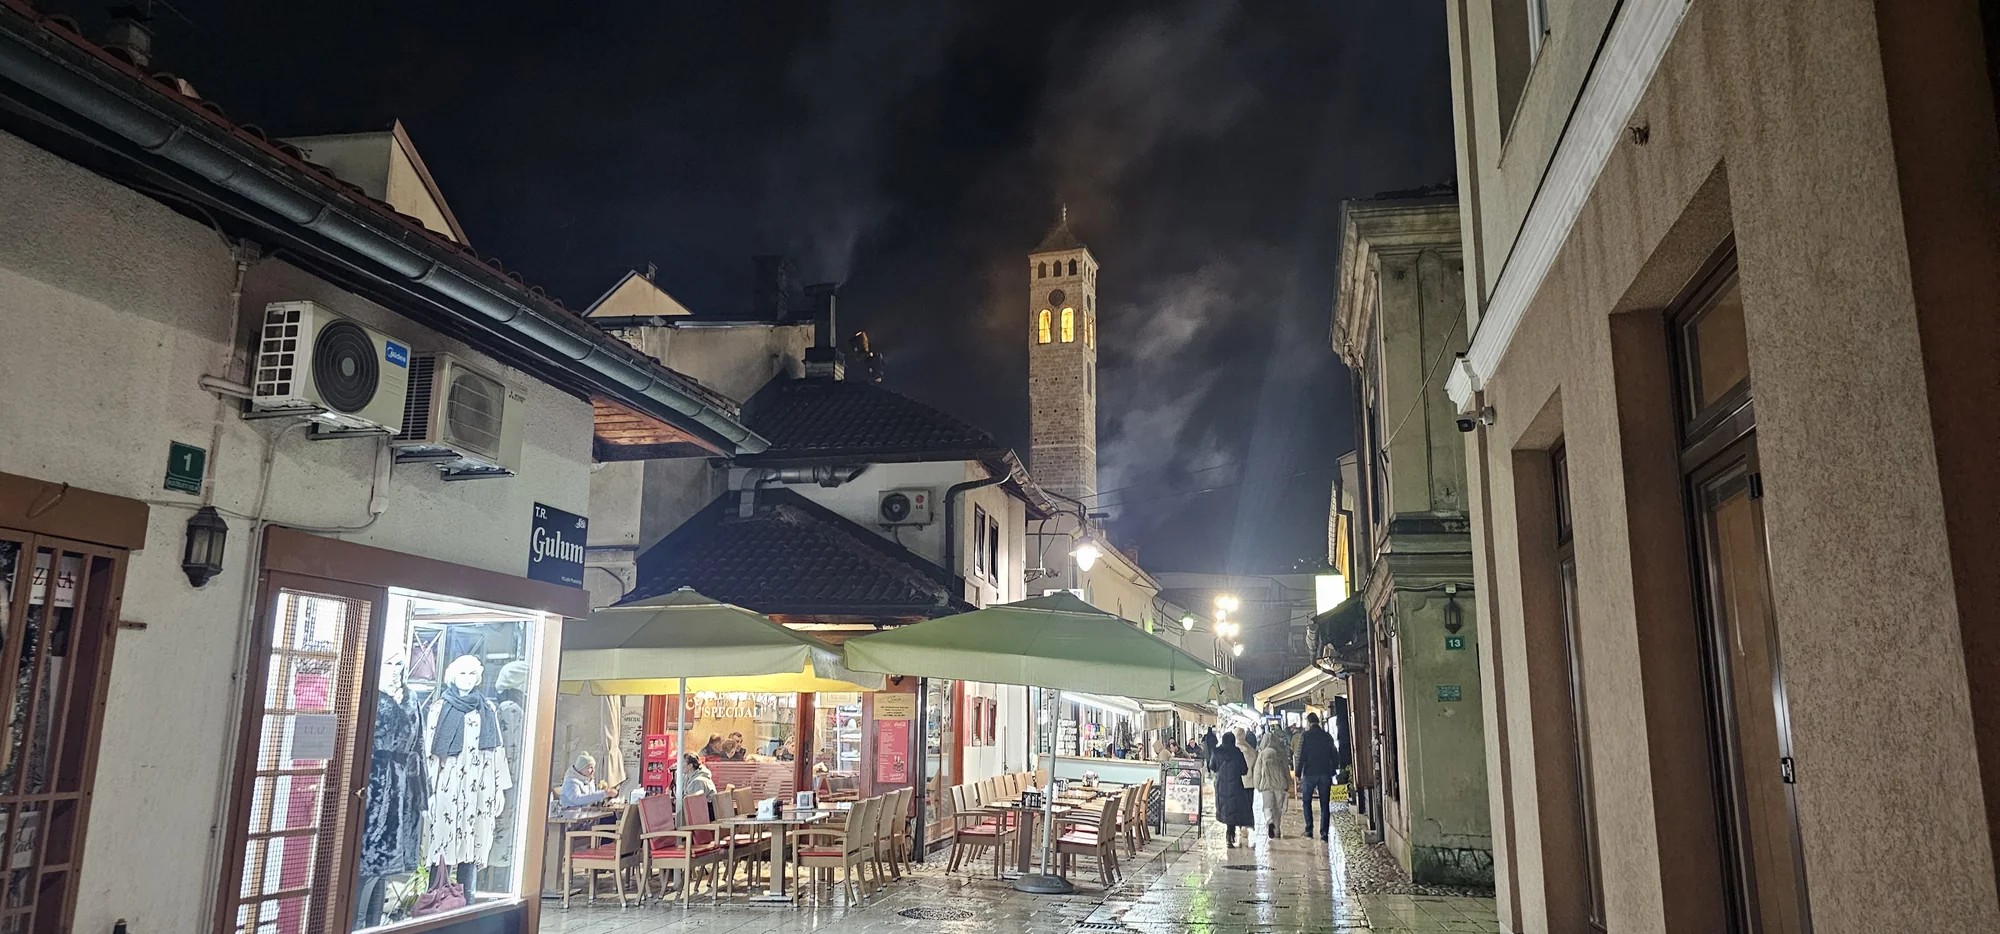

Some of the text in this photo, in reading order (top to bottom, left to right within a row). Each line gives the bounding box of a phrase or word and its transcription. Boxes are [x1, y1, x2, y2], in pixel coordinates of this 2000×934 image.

[387, 346, 406, 363] Midea
[184, 453, 192, 472] 1
[535, 506, 548, 519] T.R.
[532, 527, 584, 564] Gulum
[1448, 639, 1461, 647] 13
